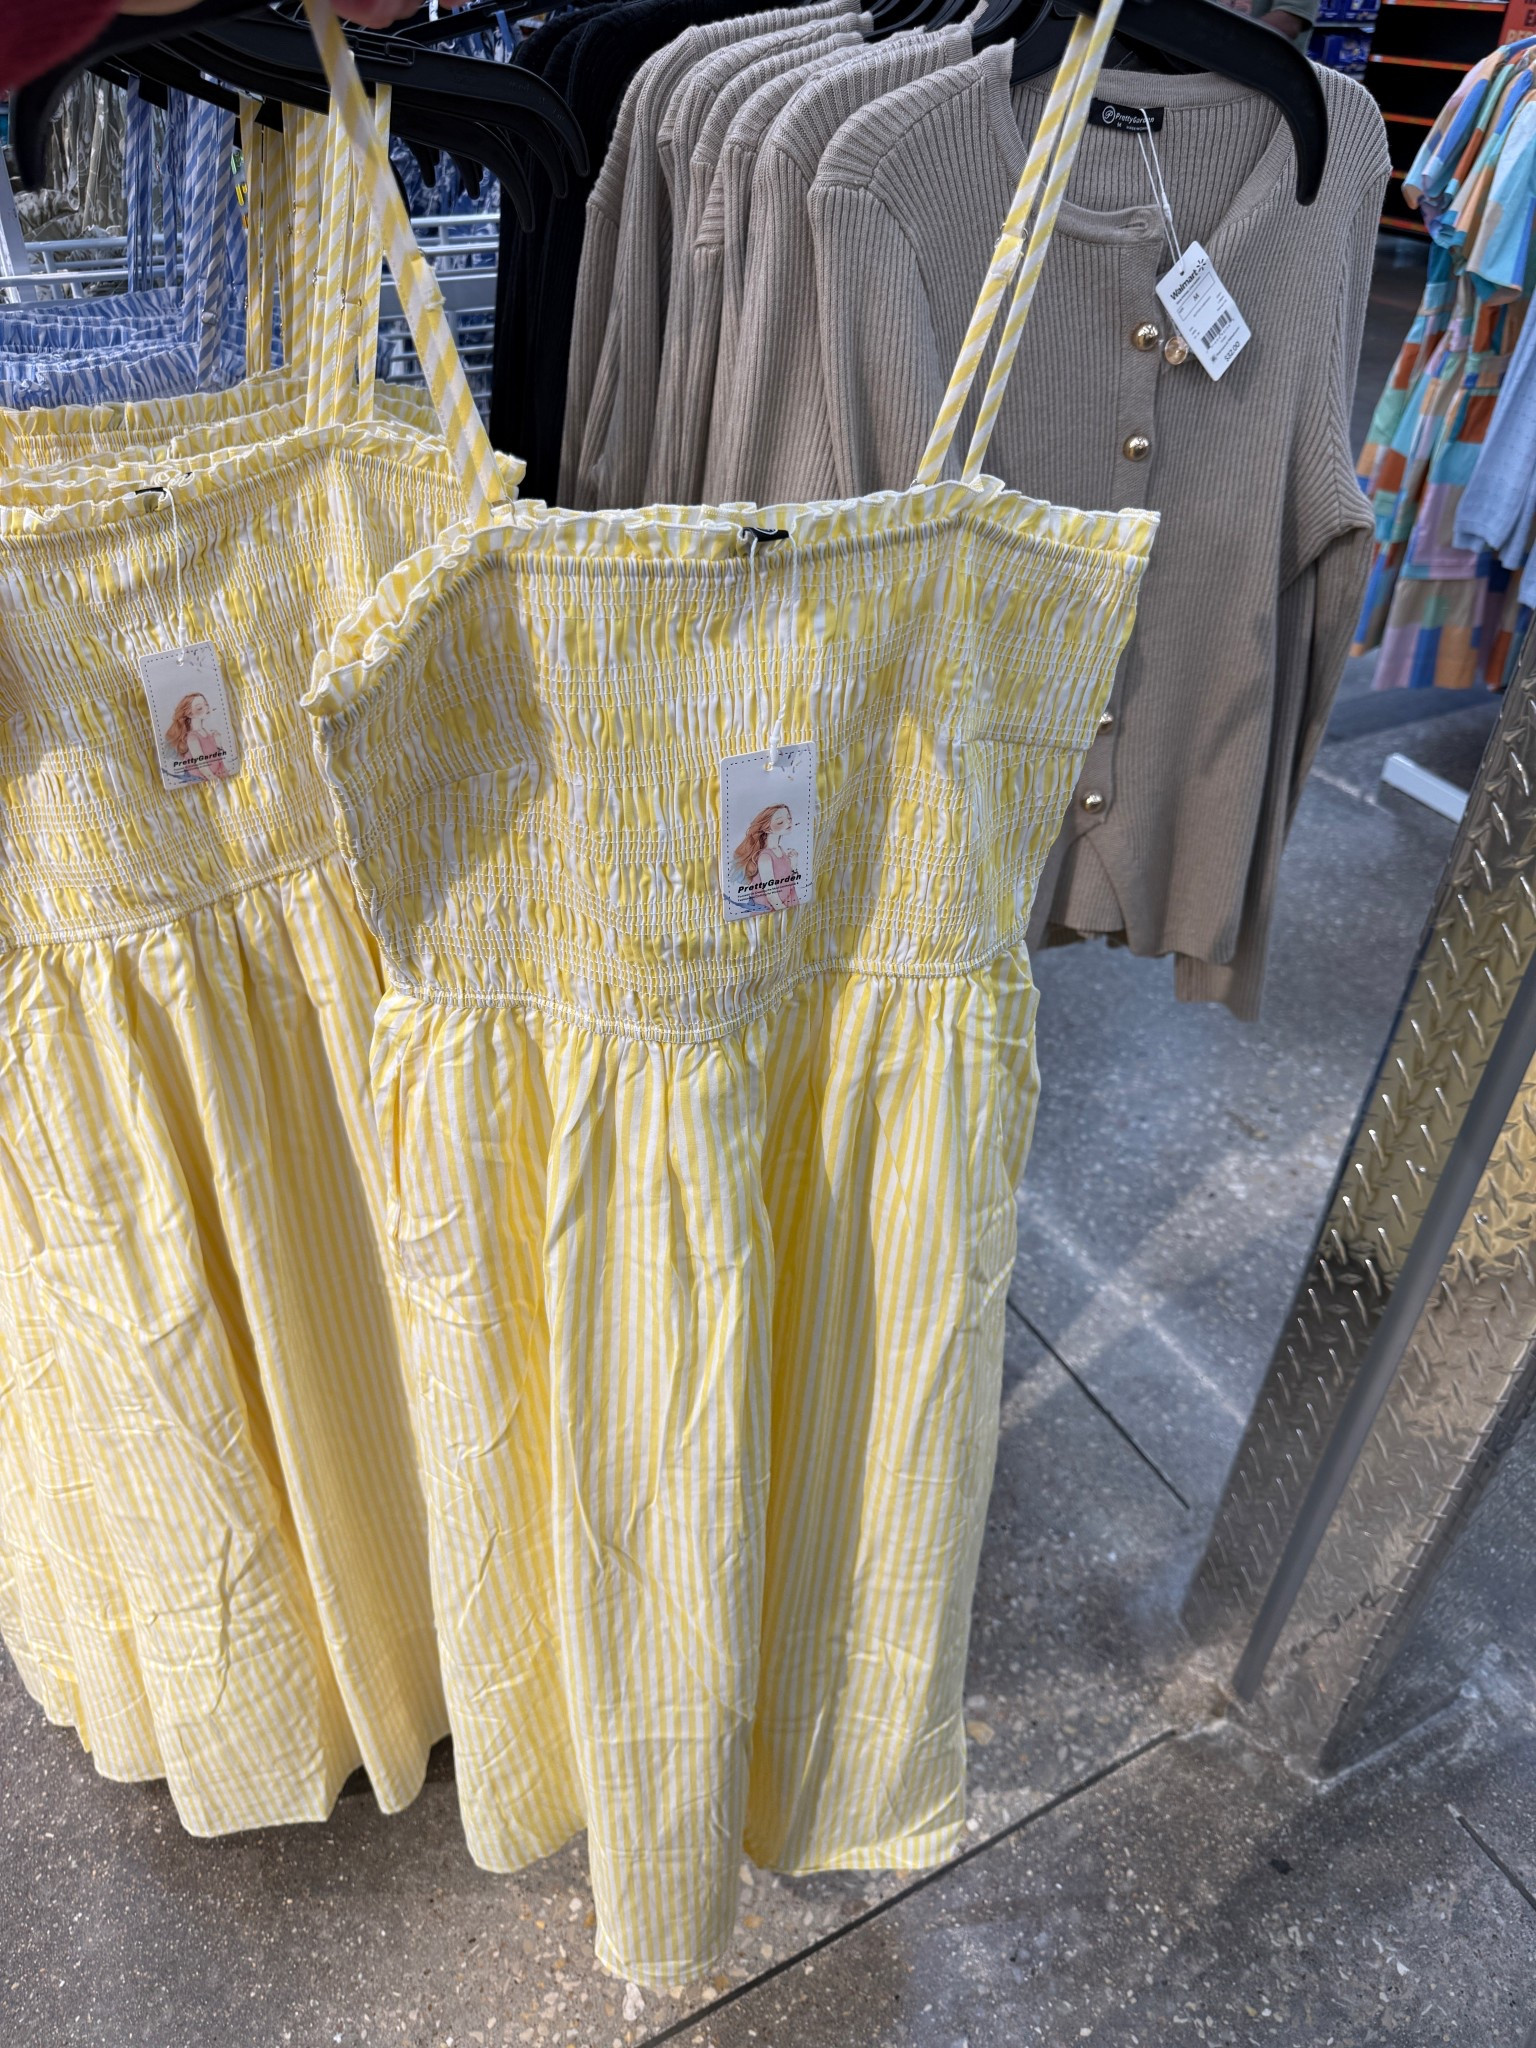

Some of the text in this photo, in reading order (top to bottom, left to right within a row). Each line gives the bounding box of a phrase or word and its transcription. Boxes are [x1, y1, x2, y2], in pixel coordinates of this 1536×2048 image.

[1170, 269, 1199, 300] Walmart
[1193, 292, 1200, 301] M
[1224, 341, 1241, 362] $32.00
[173, 750, 227, 767] PrettyGarden
[738, 874, 802, 893] PrettyGarden
